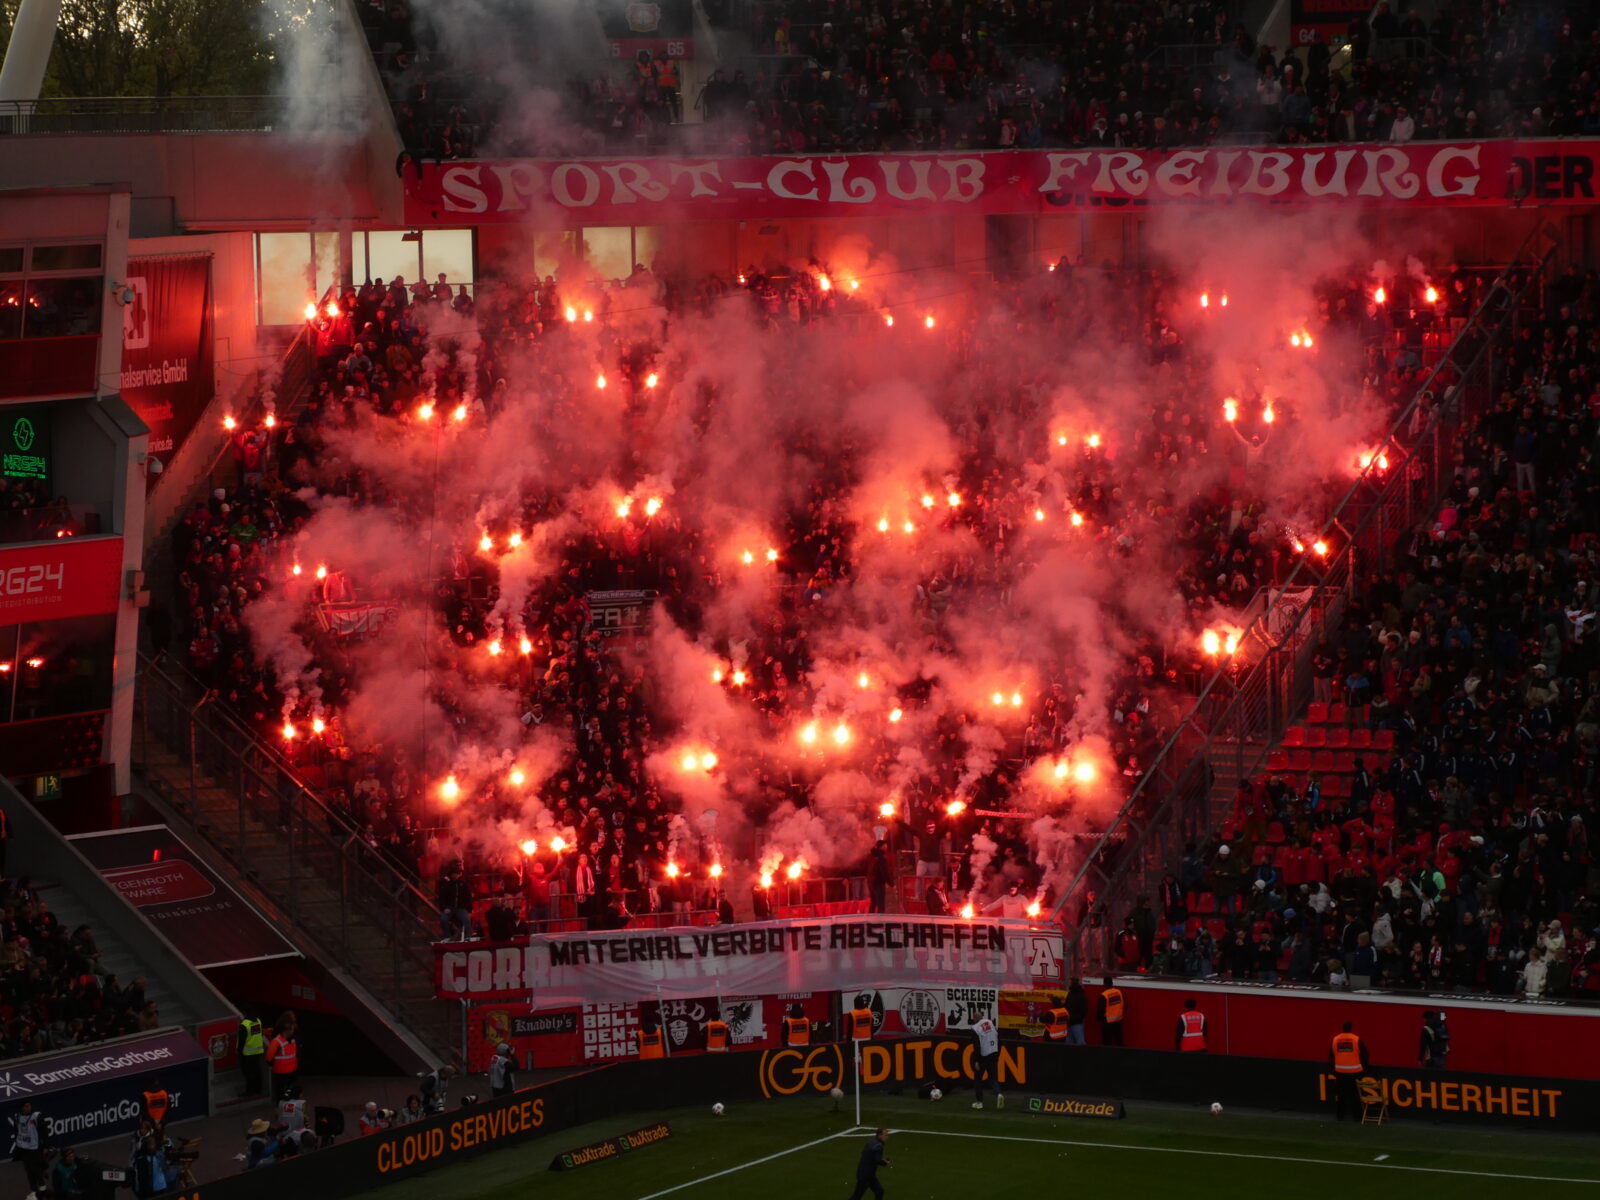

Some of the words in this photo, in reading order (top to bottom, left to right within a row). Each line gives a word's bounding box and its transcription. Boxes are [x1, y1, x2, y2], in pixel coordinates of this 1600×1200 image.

[667, 42, 685, 56] G5
[441, 158, 986, 213] SPORT-CLUB
[1038, 145, 1481, 199] FREIBURG
[162, 358, 188, 384] GmbH
[830, 923, 1005, 950] ABSCHAFFEN
[947, 988, 995, 1002] SCHEISS
[582, 1010, 640, 1029] BALL
[583, 1026, 626, 1044] DEN
[584, 1040, 640, 1060] FANS
[24, 1047, 174, 1086] BarmeniaGothaer
[1044, 1099, 1115, 1117] buXtrade
[376, 1128, 445, 1174] CLOUD
[449, 1098, 545, 1151] SERVICES
[627, 1125, 670, 1148] buXtrade
[571, 1142, 617, 1167] buXtrade
